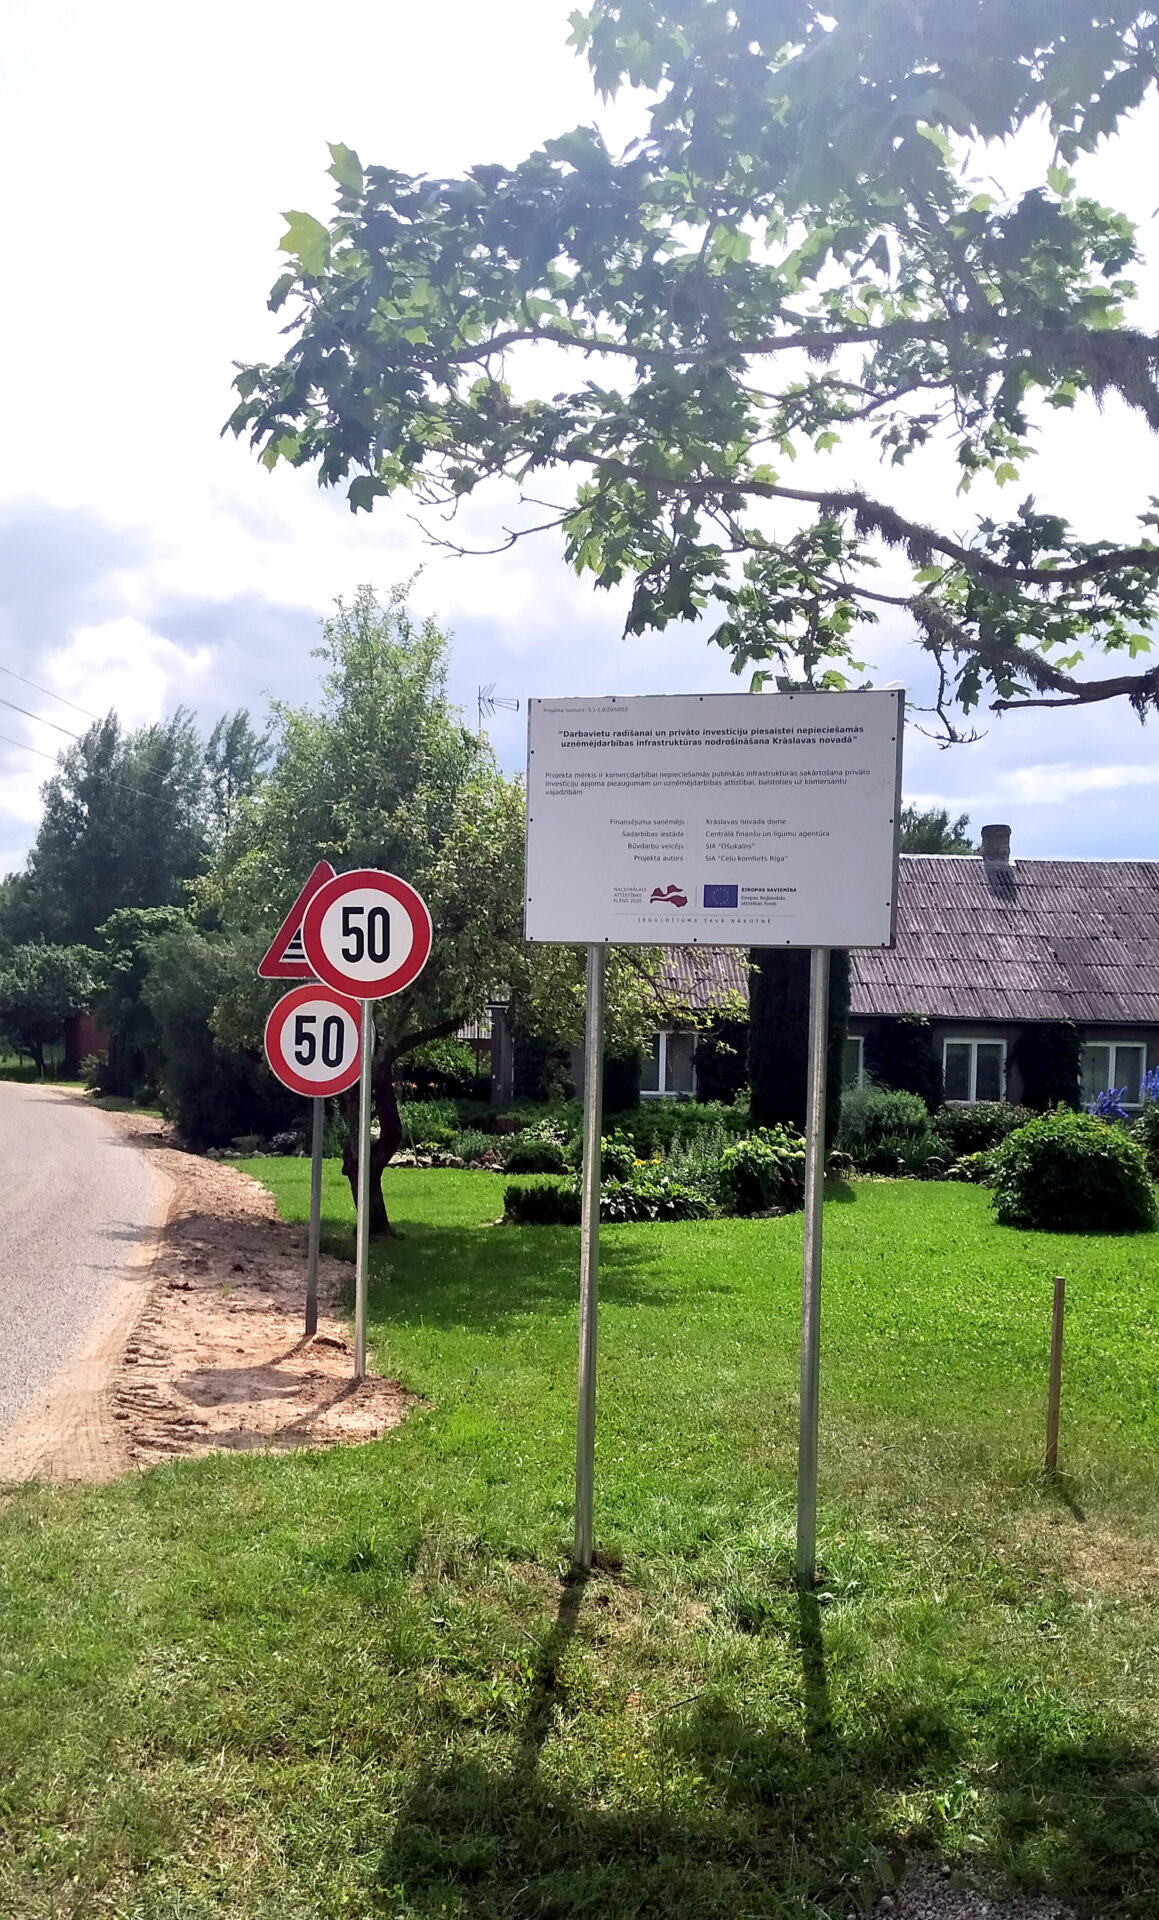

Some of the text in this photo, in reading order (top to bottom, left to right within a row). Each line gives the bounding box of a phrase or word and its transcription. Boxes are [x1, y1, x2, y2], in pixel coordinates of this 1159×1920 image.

[613, 729, 653, 737] radīšanai
[668, 728, 700, 738] privāto
[703, 727, 748, 737] investīciju
[751, 726, 794, 736] piesaistei
[796, 726, 864, 736] nepieciešamās
[561, 738, 634, 749] uzņēmējdarbības
[636, 738, 702, 747] infrastruktūras
[705, 736, 770, 746] nodrošināšana
[772, 736, 816, 745] Krāslavas
[545, 771, 573, 780] Projekta
[605, 770, 658, 779] komercdarbībai
[659, 770, 710, 779] nepieciešamās
[711, 770, 745, 778] publiskās
[746, 769, 798, 777] infrastruktūras
[800, 769, 843, 777] sakārtošana
[844, 769, 871, 777] privāto
[545, 780, 579, 788] investīciju
[580, 780, 605, 788] apjoma
[606, 779, 651, 788] pieaugumam
[758, 778, 793, 786] balstoties
[545, 788, 584, 797] vajadzībām
[609, 818, 652, 826] Finansējuma
[621, 830, 659, 838] Sadarbības
[773, 830, 797, 838] līgumu
[798, 830, 830, 838] aģentūra
[627, 842, 660, 850] Būvdarbu
[705, 842, 717, 850] SIA
[633, 854, 661, 862] Projekta
[341, 906, 391, 964] 50
[294, 1015, 345, 1068] 50
